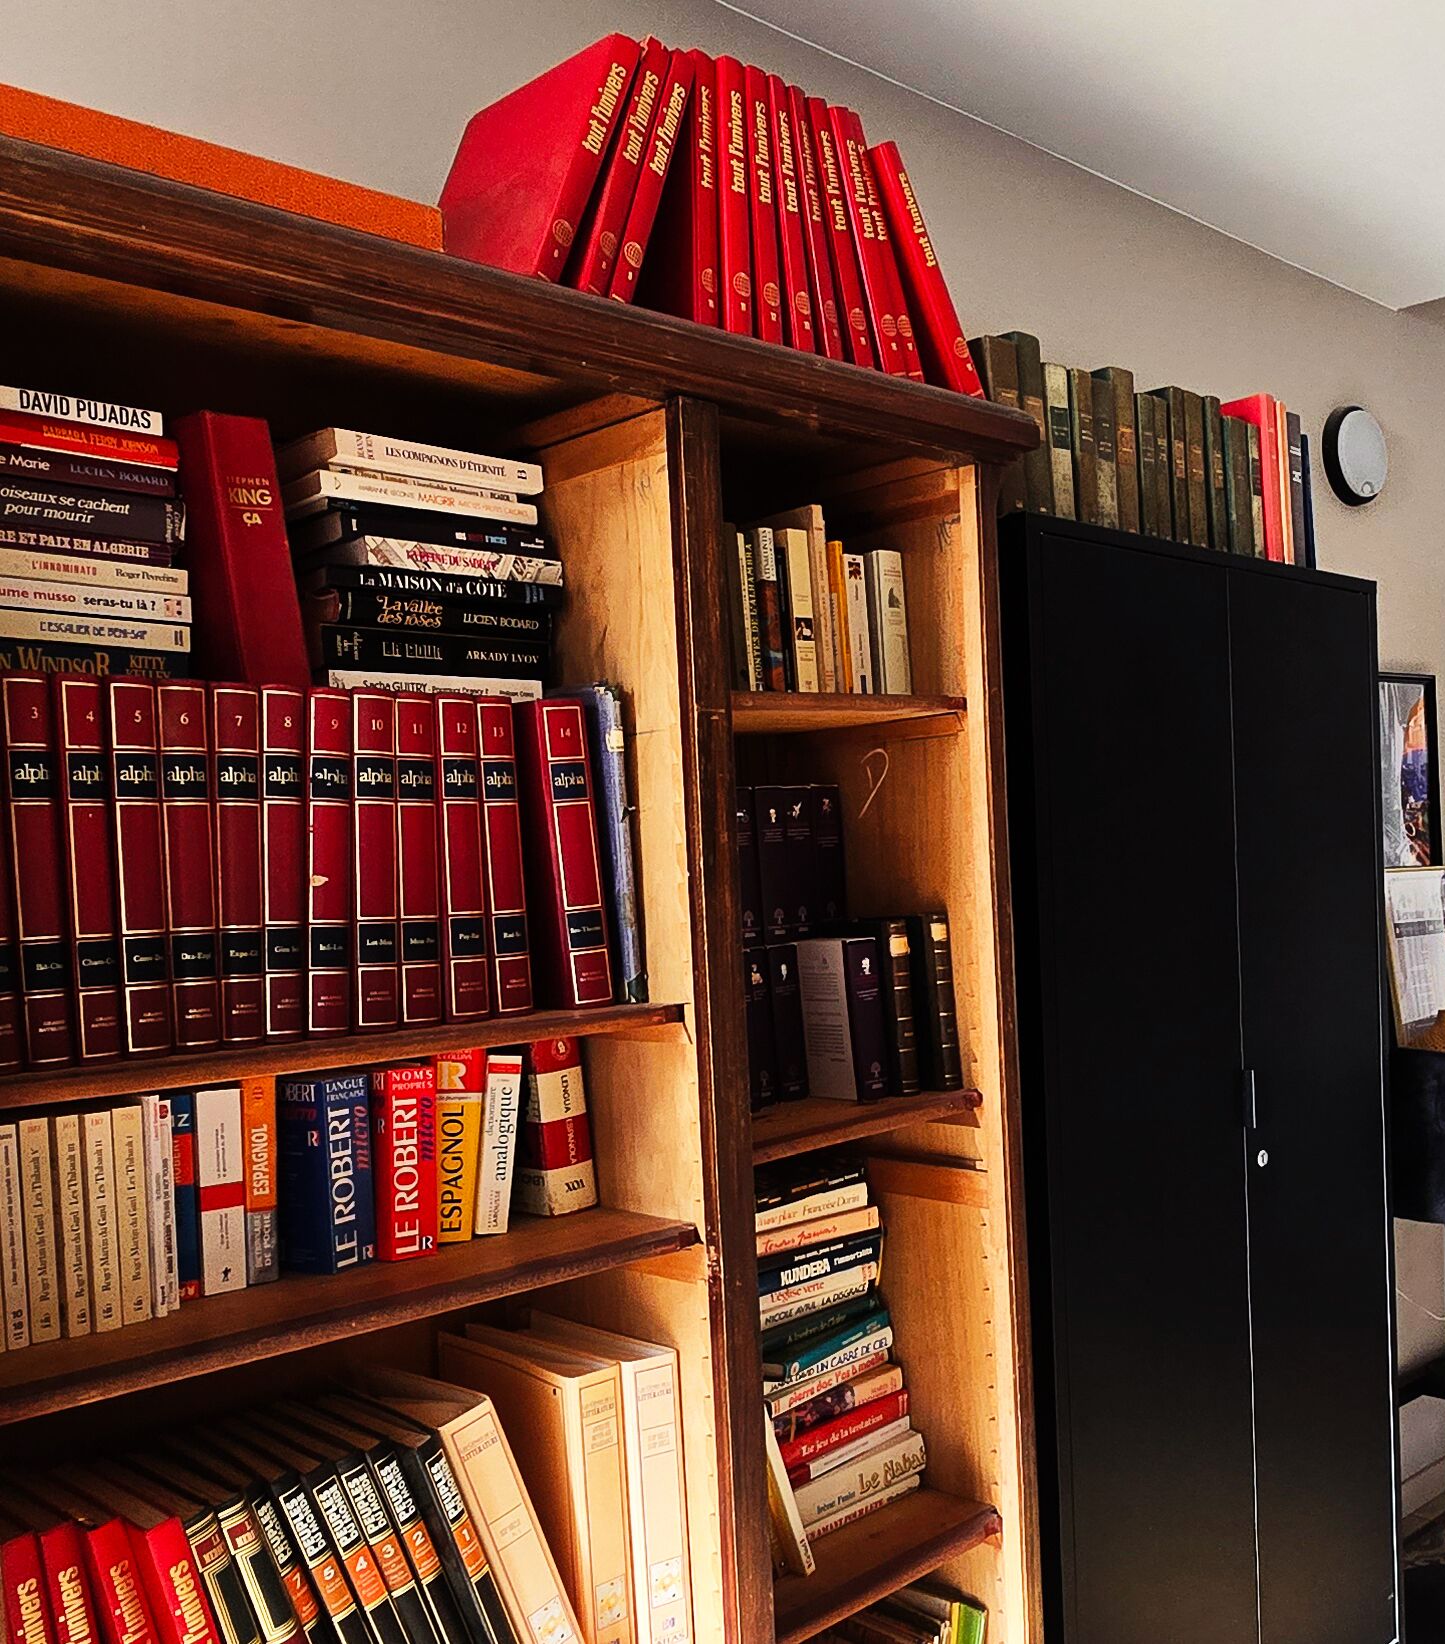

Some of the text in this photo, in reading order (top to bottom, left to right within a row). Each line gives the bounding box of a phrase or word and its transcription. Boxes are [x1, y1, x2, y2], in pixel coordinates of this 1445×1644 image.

[582, 62, 627, 154] tout l'univers
[622, 71, 659, 165] tout l'univers
[650, 83, 685, 176] tout l'univers
[728, 90, 745, 194] tout l'univers
[754, 101, 771, 204] tout l'univers
[779, 110, 798, 212] tout l'univers
[821, 130, 847, 231] tout l'univers
[847, 140, 875, 238] tout l'univers
[919, 236, 936, 267] tout
[19, 389, 152, 429] DAVID PUJADAS
[42, 425, 159, 455] BARBARA JOHNSON
[9, 454, 51, 471] Marie
[385, 446, 401, 458] LES
[401, 448, 458, 469] COMPAGNONS
[459, 459, 506, 477] D'ÉTERNITÉ
[70, 463, 169, 487] LUCIEN BODARD
[0, 485, 131, 515] oiseaux se cachent
[228, 487, 272, 505] KING
[4, 503, 95, 524] pour mourir
[242, 512, 263, 527] ÇA
[18, 532, 38, 545] ET
[39, 534, 72, 549] PAIX
[73, 538, 91, 551] EN
[93, 542, 149, 559] ALGERIE
[32, 560, 97, 576] L'INNOMINATO
[115, 568, 140, 581] Roger
[359, 573, 507, 598] La MAISON d'à CÔTÉ
[745, 544, 759, 616] L'ALHAMBRA
[33, 591, 76, 603] musso
[83, 596, 133, 609] seras-tu
[136, 599, 148, 611] là
[376, 595, 400, 610] La
[40, 621, 105, 637] L'ESCALIER DE
[463, 613, 539, 630] LUCIEN BODARD
[750, 617, 759, 633] DE
[16, 646, 110, 676] WINDSOR
[129, 654, 166, 670] KITTY
[466, 650, 539, 665] ARKADY LVOV
[752, 635, 764, 679] CONTES
[363, 680, 428, 693] Sacha GUITRY
[31, 707, 39, 719] 3
[86, 711, 95, 722] 4
[134, 710, 142, 722] 5
[180, 712, 189, 725] 6
[235, 715, 243, 727] 7
[284, 716, 293, 728] 8
[331, 719, 339, 731] 9
[371, 719, 383, 731] 10
[413, 723, 423, 735] 11
[456, 723, 467, 734] 12
[493, 727, 504, 738] 13
[560, 728, 571, 739] 14
[167, 765, 205, 785] alpha
[220, 766, 256, 785] alpha
[359, 767, 392, 785] alpha
[401, 770, 432, 786] alpha
[446, 768, 475, 786] alpha
[486, 770, 514, 787] alpha
[554, 772, 584, 789] alpha
[325, 1077, 365, 1093] LANGUE
[391, 1069, 433, 1081] NOMS
[391, 1079, 433, 1091] PROPRES
[326, 1088, 365, 1102] FRANÇAISE
[560, 1074, 569, 1114] LENGUA
[485, 1086, 496, 1136] dictionnaire
[354, 1104, 370, 1171] micro
[420, 1095, 435, 1162] micro
[495, 1086, 517, 1183] analogique
[93, 1149, 105, 1183] Thibault
[124, 1141, 135, 1175] Thibault
[252, 1124, 268, 1196] ESPAGNOL
[440, 1105, 465, 1233] ESPAGNOL
[30, 1157, 43, 1191] Thibault
[66, 1154, 78, 1189] Thibault
[391, 1096, 420, 1255] LE ROBERT
[327, 1105, 358, 1269] LE ROBERT
[96, 1205, 107, 1226] Gard
[126, 1196, 137, 1216] Gard
[492, 1190, 500, 1228] LAROUSSE
[34, 1214, 46, 1235] Gard
[70, 1211, 81, 1232] Gard
[253, 1214, 263, 1268] DICTIONNAIRE
[262, 1213, 271, 1266] DE POCHE
[781, 1258, 831, 1286] KUNDERA
[770, 1281, 825, 1304] L'église verte
[765, 1283, 866, 1326] NICOLE AVRIL LA DISGRACE
[816, 1337, 888, 1374] UN CARRÉ DE CIEL
[789, 1388, 815, 1407] pierre
[801, 1413, 883, 1456] Le jeu de la tentation
[391, 1461, 410, 1499] MONDE
[431, 1462, 458, 1519] PEUPLES
[858, 1472, 880, 1494] Le
[329, 1484, 351, 1521] MONDE
[358, 1473, 381, 1512] MONDE
[380, 1465, 407, 1522] PEUPLES
[297, 1492, 318, 1532] MONDE
[348, 1477, 376, 1534] PEUPLES
[286, 1497, 315, 1557] PEUPLES
[319, 1489, 350, 1547] PEUPLES
[258, 1504, 288, 1565] PEUPLES
[413, 1530, 425, 1545] 2
[461, 1529, 470, 1542] 1
[382, 1544, 395, 1558] 3
[323, 1566, 334, 1581] 5
[355, 1556, 368, 1572] 4
